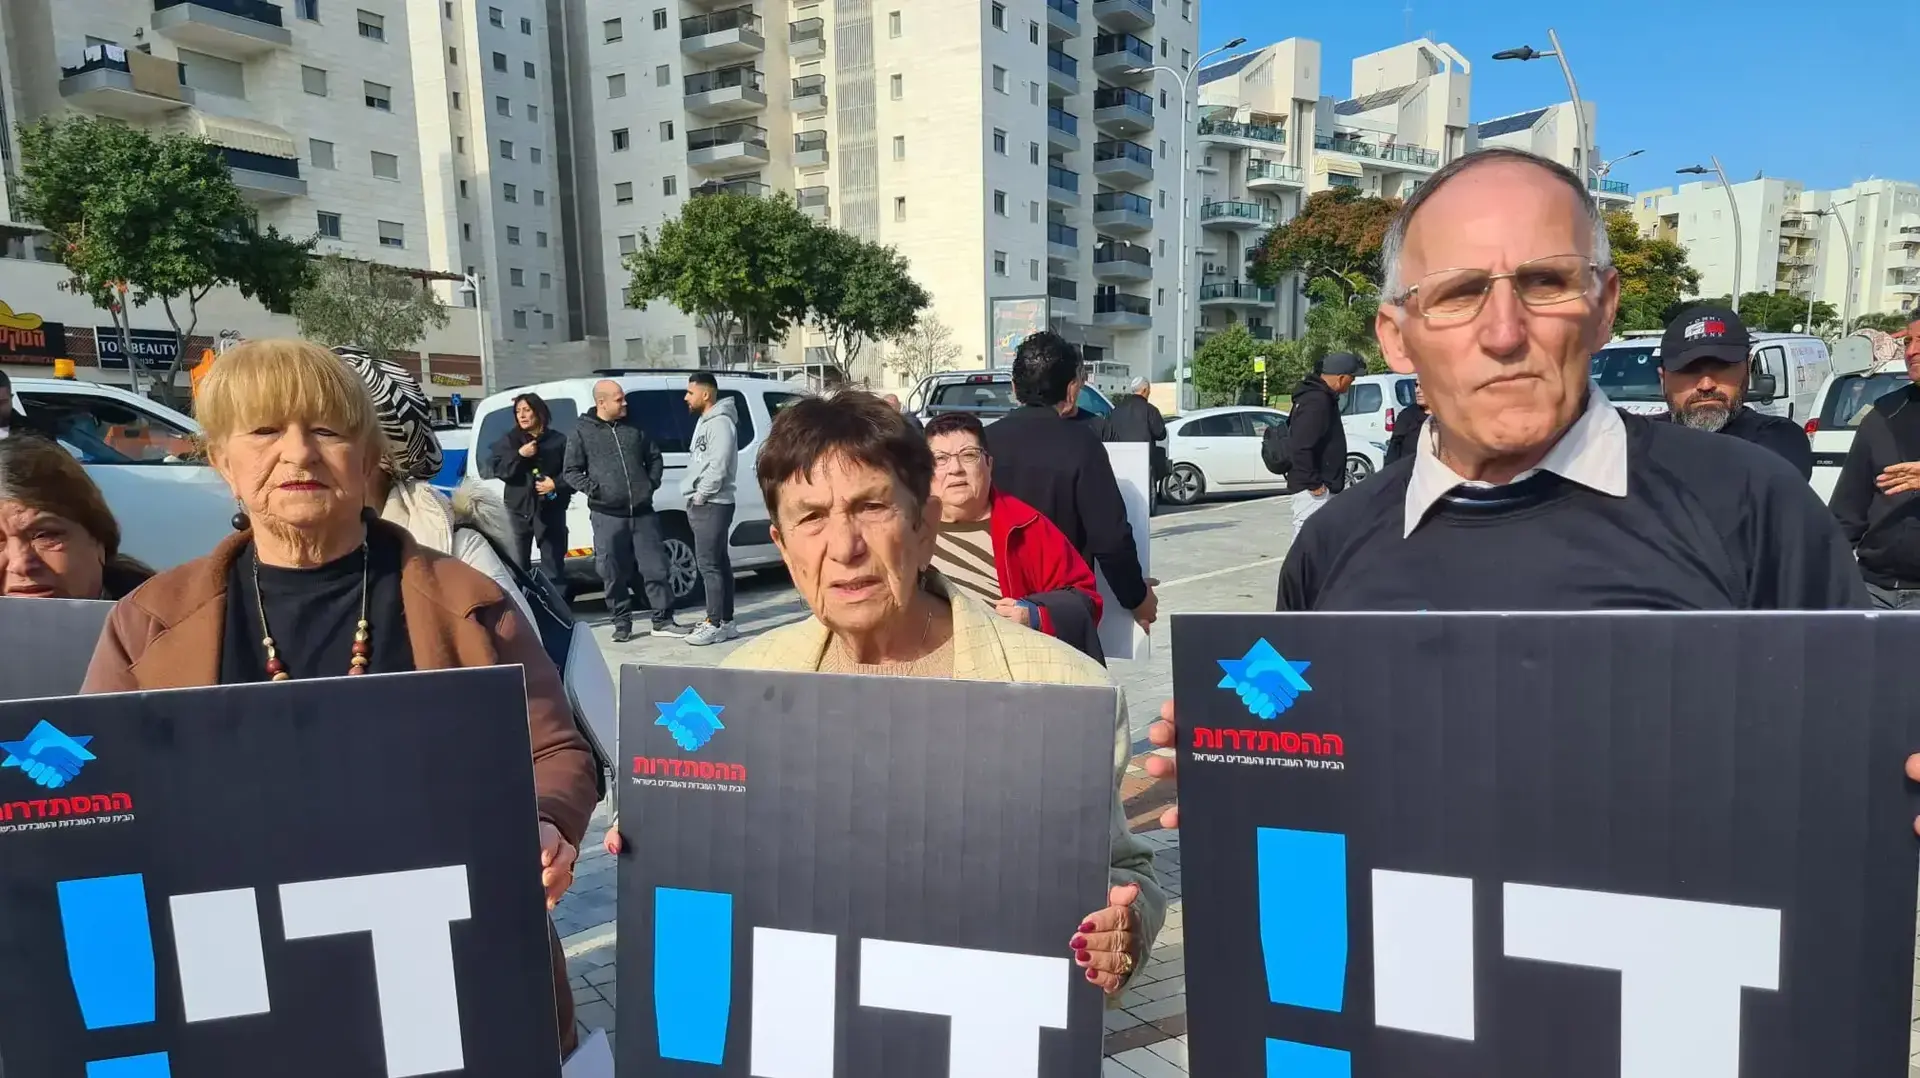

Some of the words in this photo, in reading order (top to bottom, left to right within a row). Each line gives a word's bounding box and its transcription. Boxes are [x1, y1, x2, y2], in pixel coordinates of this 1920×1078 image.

[99, 341, 128, 353] TO
[131, 343, 177, 355] BEAUTY
[1193, 727, 1344, 756] ההסתדרות
[1192, 752, 1225, 763] בישראל
[1226, 754, 1264, 766] והעובדים
[1266, 757, 1303, 768] העובדות
[1305, 758, 1318, 768] של
[1321, 760, 1344, 770] הבית
[633, 756, 746, 782] ההסתדרות
[632, 777, 657, 786] בישראל
[658, 779, 686, 789] והעובדים
[688, 782, 716, 791] העובדות
[717, 783, 728, 792] של
[729, 785, 746, 793] הבית
[0, 792, 132, 820] ההסתדרו
[59, 816, 96, 828] העובדות
[97, 815, 111, 824] של
[113, 813, 135, 822] הבית
[18, 820, 57, 831] והעובדים
